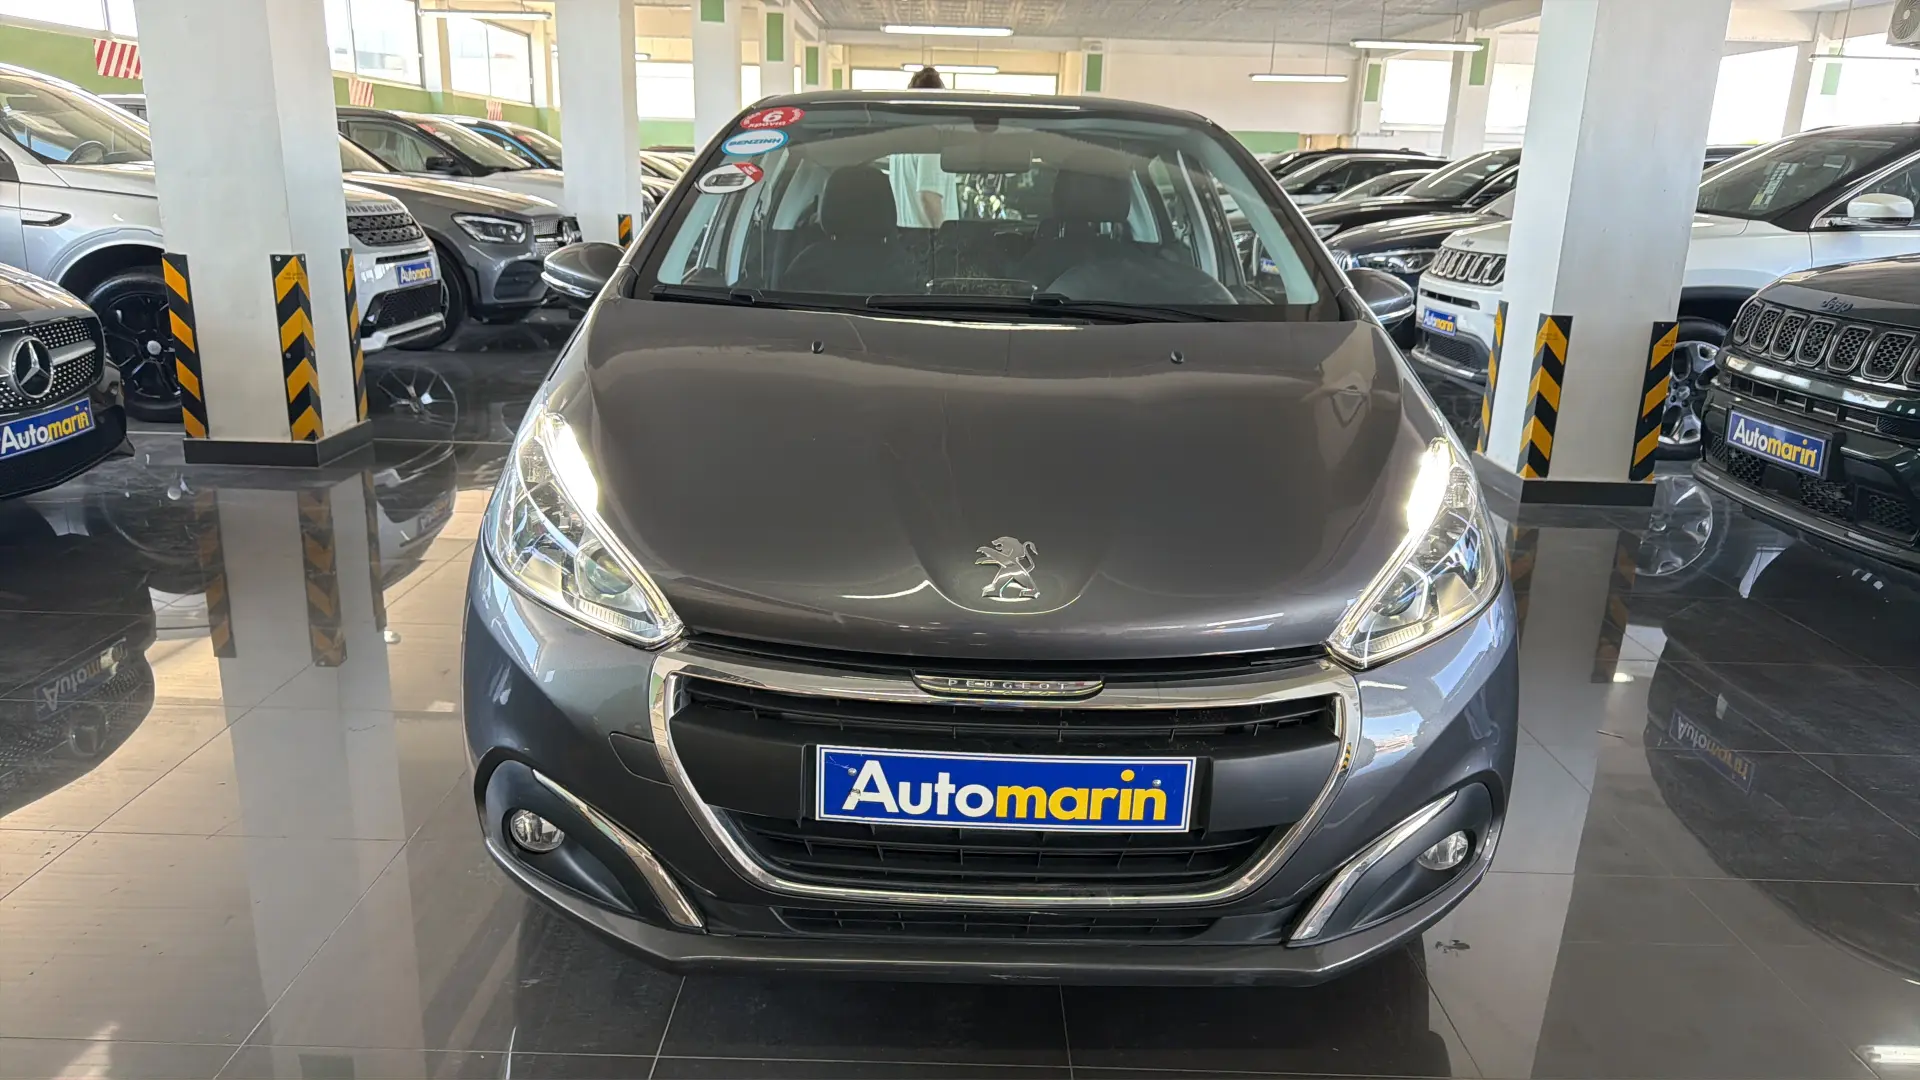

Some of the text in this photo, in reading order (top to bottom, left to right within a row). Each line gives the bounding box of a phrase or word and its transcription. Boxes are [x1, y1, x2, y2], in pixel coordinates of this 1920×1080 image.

[762, 110, 784, 122] 6
[1, 405, 89, 454] Automarin
[1732, 418, 1817, 468] Automarin
[948, 678, 1068, 690] PEUGEOT
[842, 760, 1167, 821] Automarin
